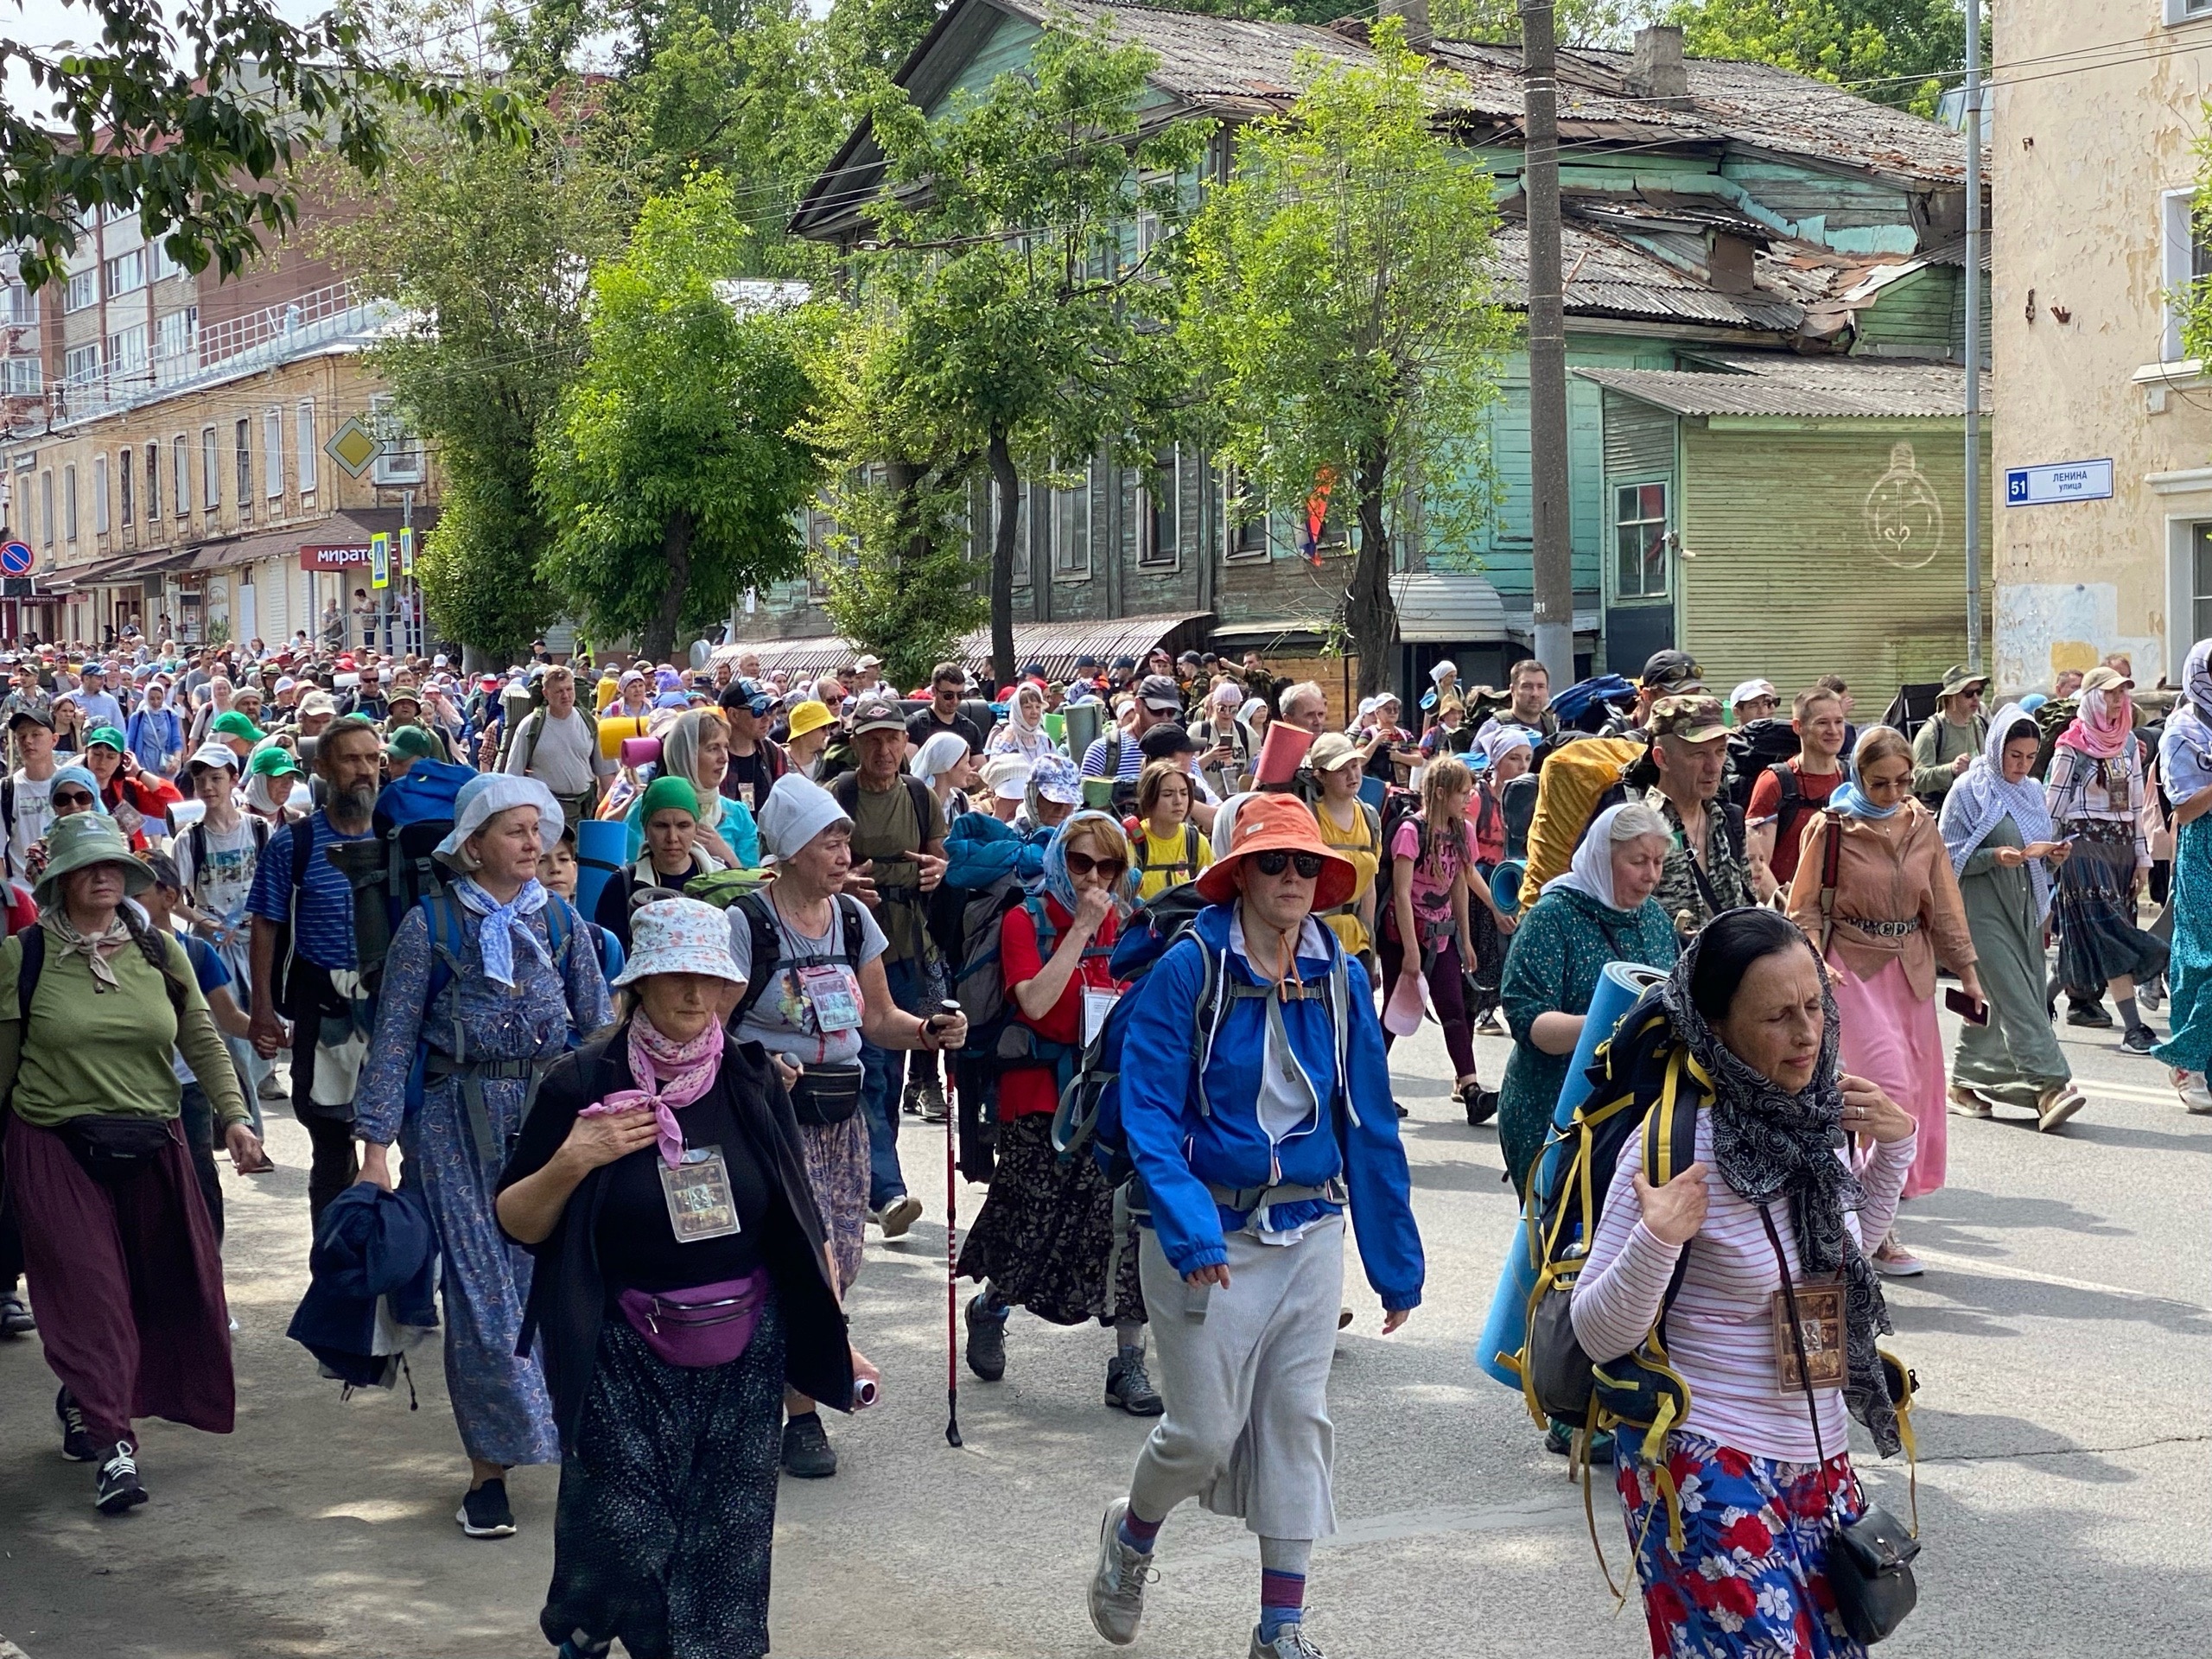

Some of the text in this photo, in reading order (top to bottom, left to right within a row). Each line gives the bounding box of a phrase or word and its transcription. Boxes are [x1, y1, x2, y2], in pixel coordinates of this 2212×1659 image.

[2053, 470, 2088, 482] ЛЕНИНА
[2011, 480, 2026, 495] 51
[2059, 482, 2082, 493] улица
